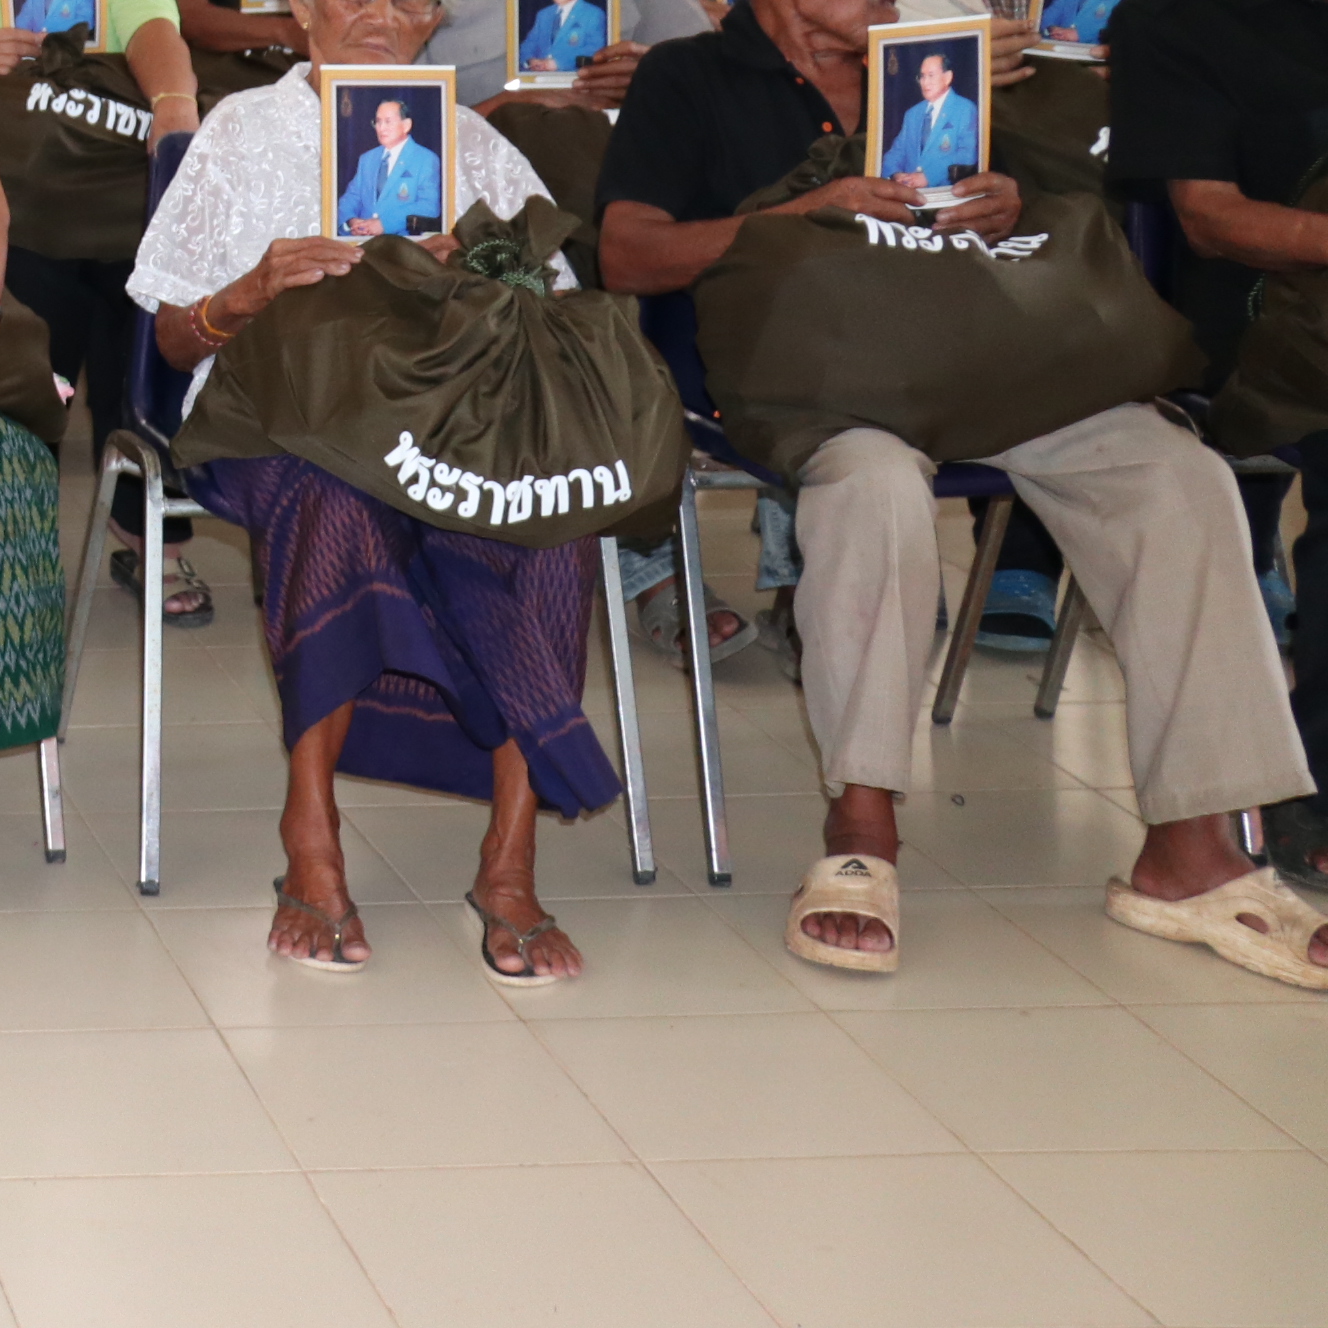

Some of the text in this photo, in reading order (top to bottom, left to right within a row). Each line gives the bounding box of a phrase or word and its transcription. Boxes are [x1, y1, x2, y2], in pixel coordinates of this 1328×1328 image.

[383, 430, 632, 525] พระราชทาน
[834, 870, 873, 878] ADDA
